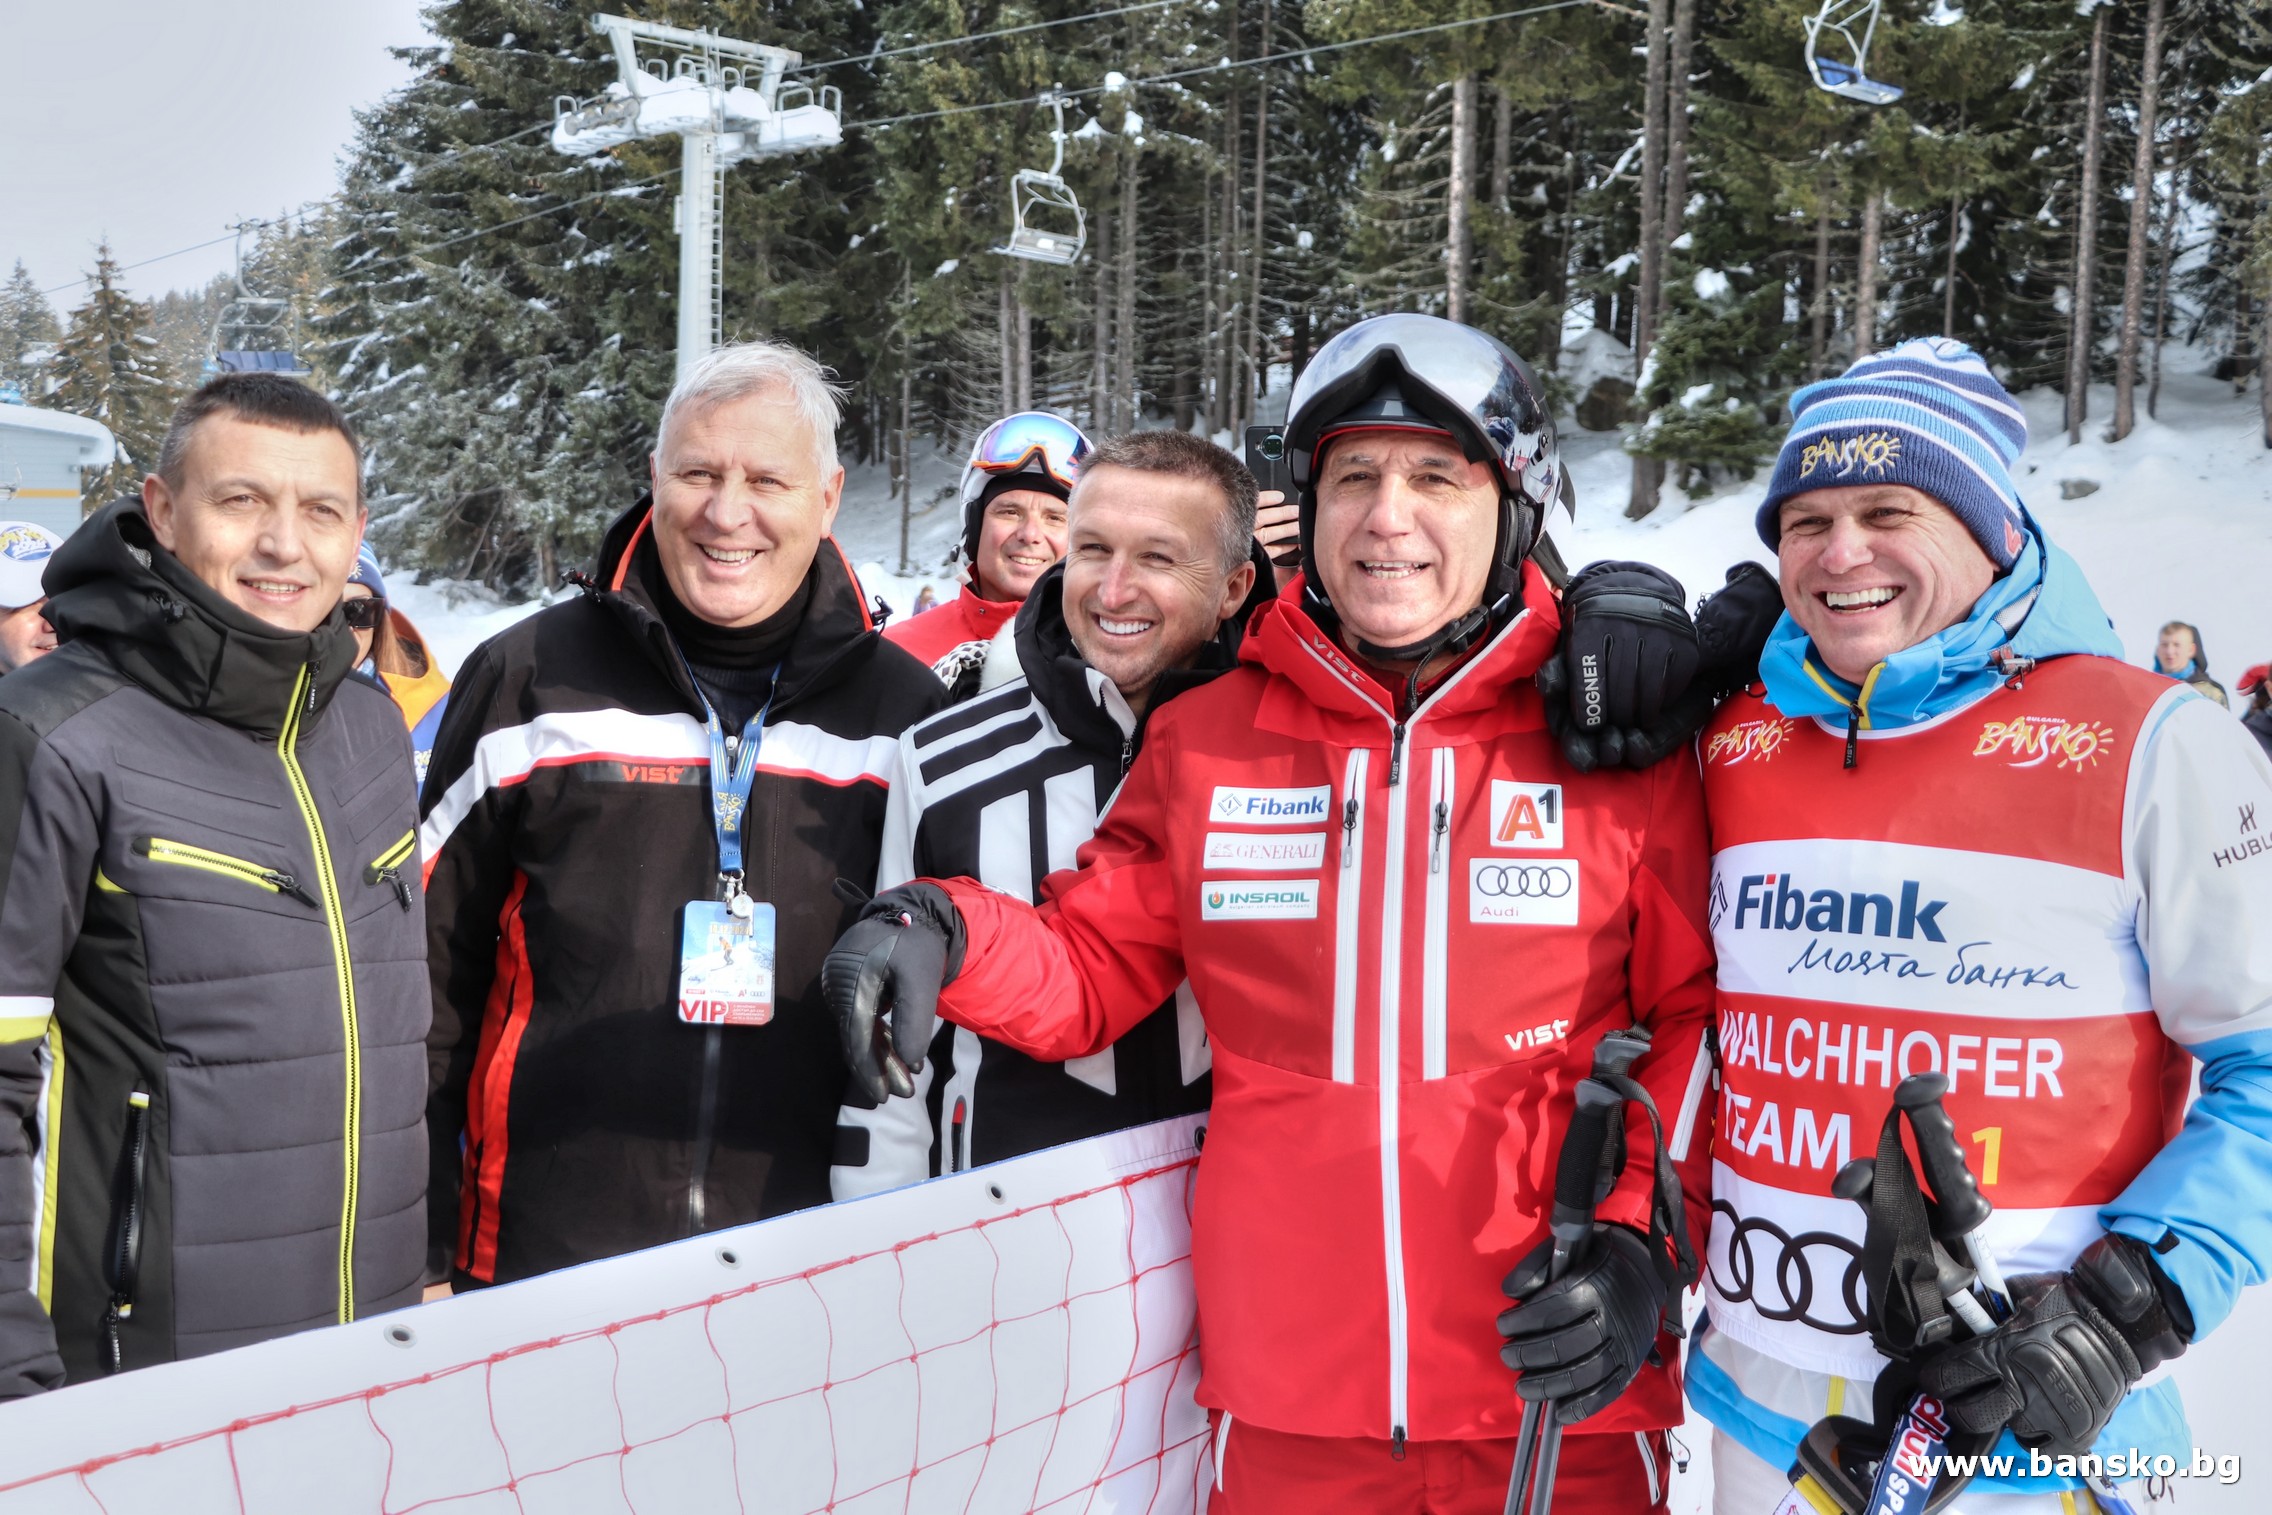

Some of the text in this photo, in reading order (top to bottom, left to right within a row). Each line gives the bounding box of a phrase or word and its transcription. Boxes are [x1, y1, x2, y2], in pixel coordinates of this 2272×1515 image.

[1800, 433, 1897, 478] BANSKO
[1582, 654, 1601, 726] BOGNER
[1708, 719, 1787, 766] BANSKO
[1973, 716, 2102, 769] BANSKO
[2025, 716, 2066, 724] BULGARIA
[1246, 795, 1324, 816] Fibank
[1496, 788, 1557, 841] A1
[1236, 844, 1318, 859] GENERALI
[2213, 832, 2272, 868] HUBL
[1229, 891, 1310, 904] INSAOIL
[1480, 906, 1519, 917] Audi
[1735, 873, 1949, 943] Fibank
[1787, 938, 2080, 989] Моята банка
[680, 1000, 727, 1022] VIP
[1718, 1008, 2064, 1098] WALCHHOFER
[1724, 1082, 2002, 1185] TEAM 1
